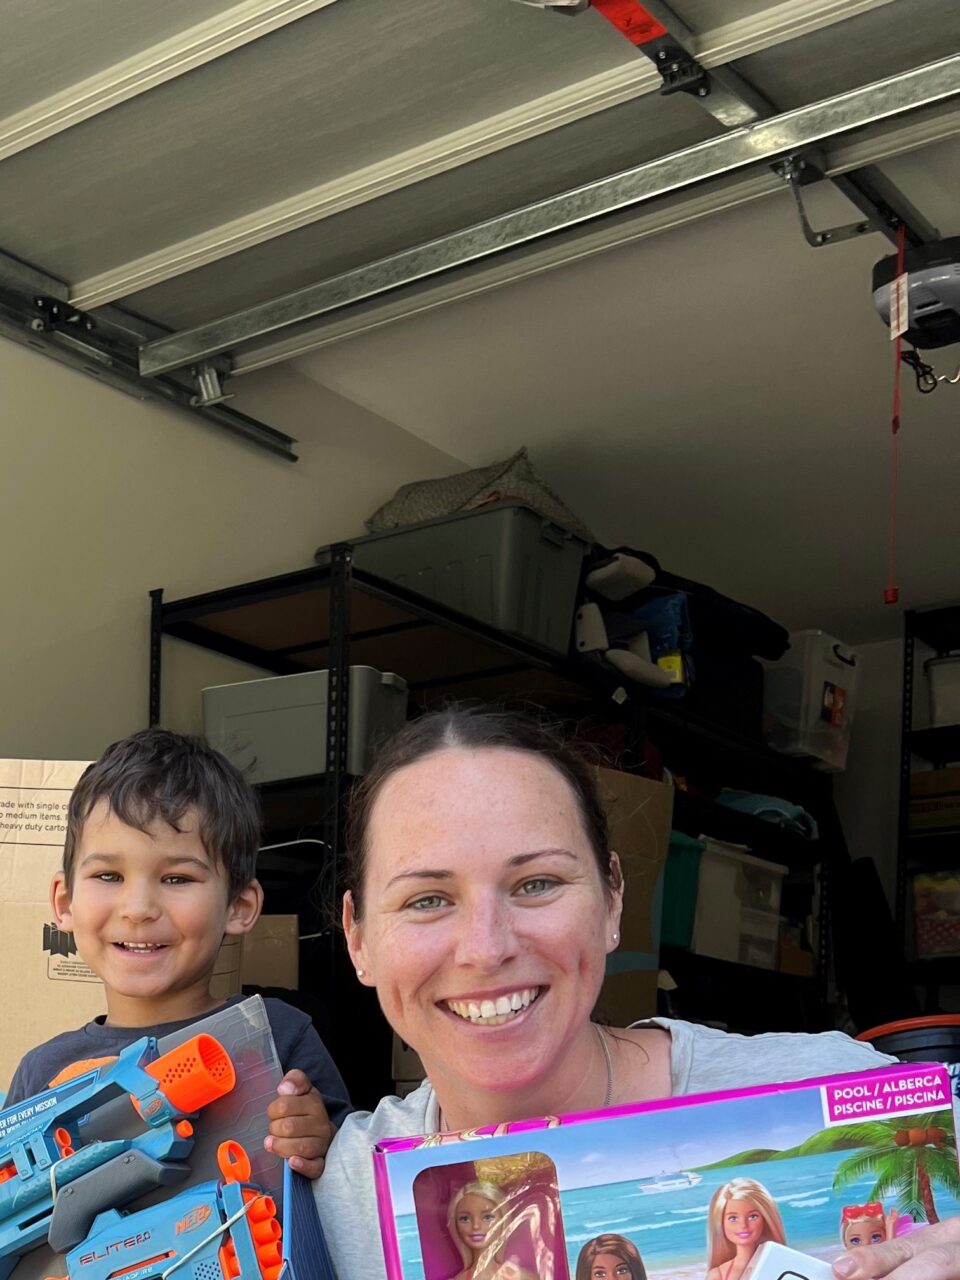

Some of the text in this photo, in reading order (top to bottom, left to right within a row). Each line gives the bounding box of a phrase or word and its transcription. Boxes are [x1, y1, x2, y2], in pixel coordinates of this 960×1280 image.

[5, 812, 38, 820] medium
[36, 803, 60, 811] single
[0, 822, 23, 831] heavy
[24, 823, 43, 832] duty
[833, 1074, 943, 1101] POOL ALBERCA
[6, 1114, 18, 1127] FOR
[17, 1106, 35, 1122] EVERY
[34, 1096, 58, 1114] MISSION
[833, 1089, 946, 1116] PISCINE PISCINA
[79, 1234, 137, 1266] ELITE
